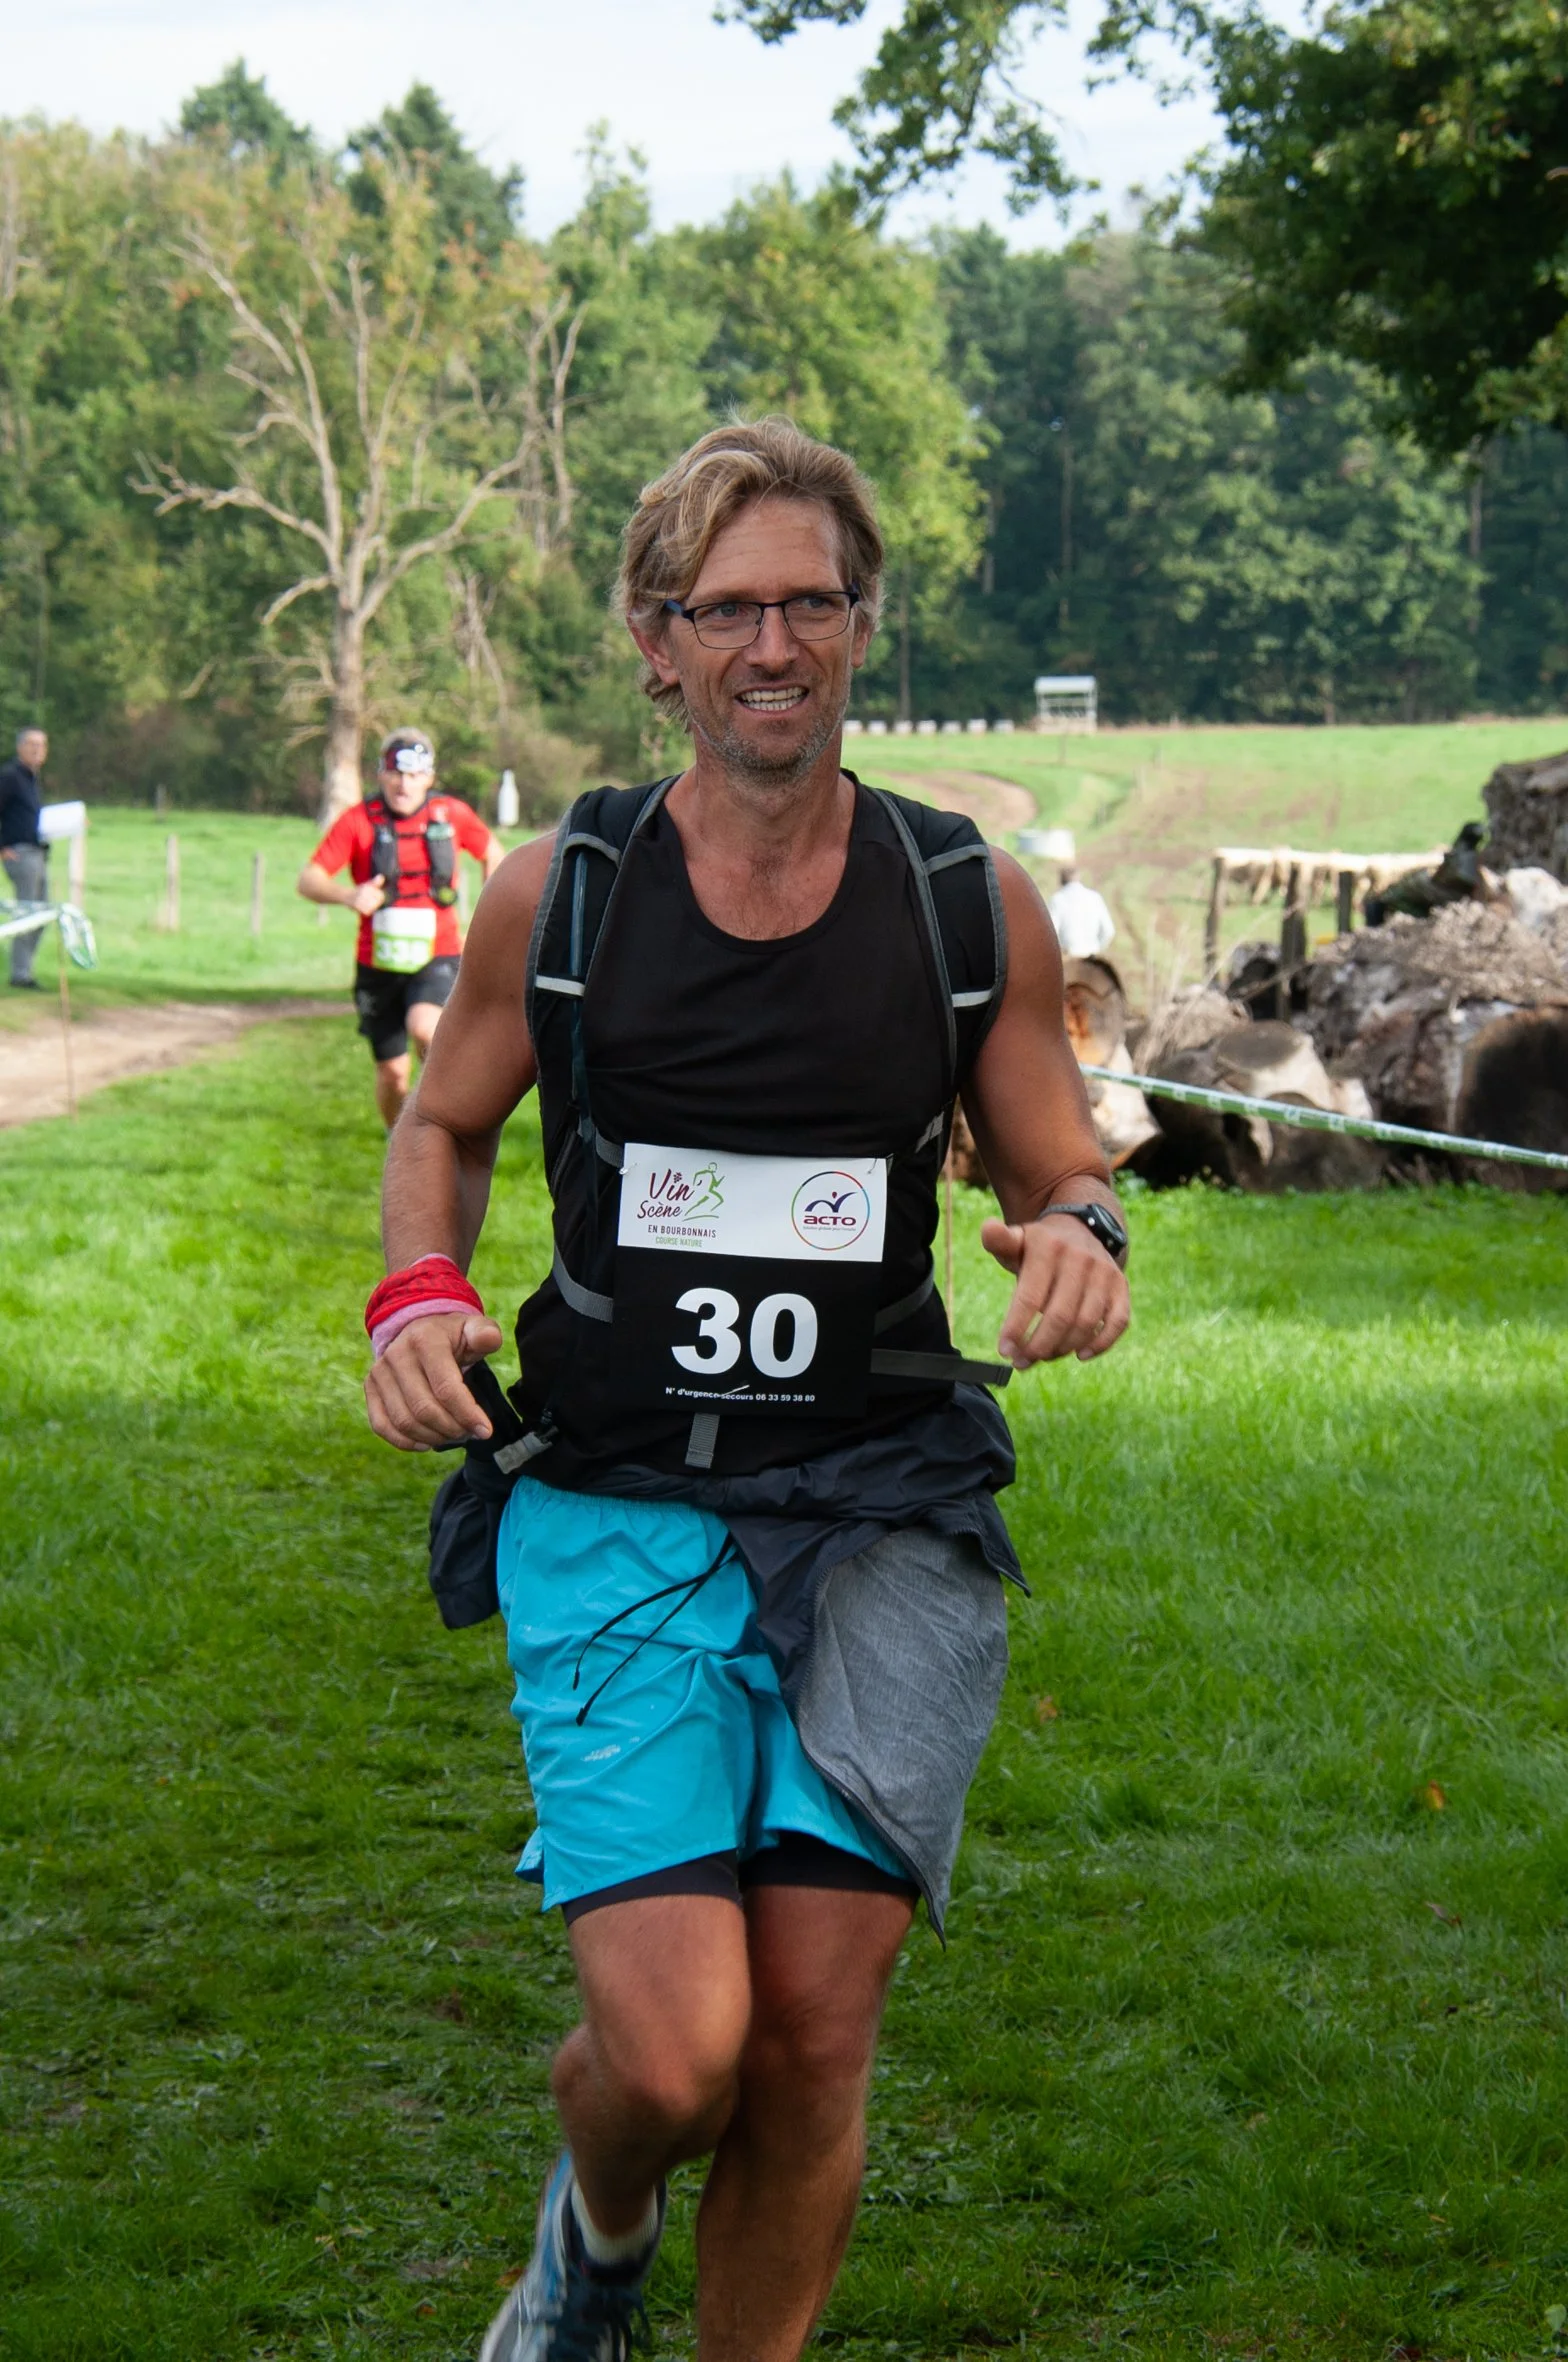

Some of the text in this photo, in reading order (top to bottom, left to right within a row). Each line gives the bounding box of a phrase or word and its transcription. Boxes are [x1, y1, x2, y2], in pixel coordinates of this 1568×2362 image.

[637, 1200, 683, 1219] Scène
[647, 1224, 717, 1239] EN BOURBONNAIS
[655, 1236, 702, 1248] COURSE NATURE
[671, 1287, 818, 1379] 30
[755, 1393, 767, 1401] 06
[768, 1394, 779, 1402] 33
[780, 1394, 792, 1402] 59
[792, 1394, 804, 1403] 38
